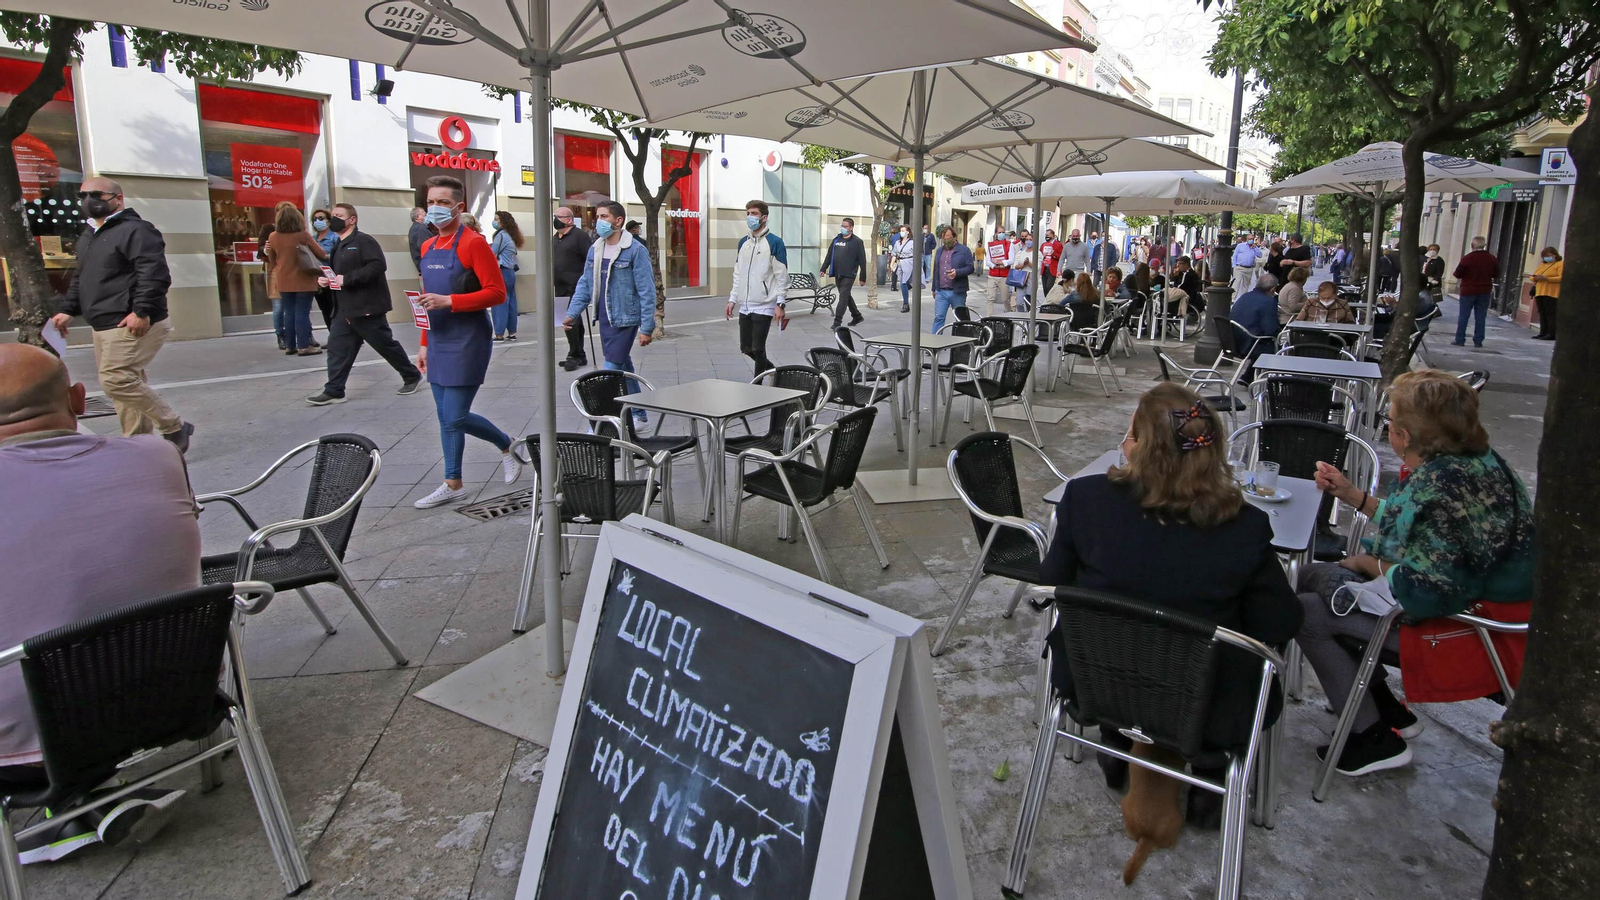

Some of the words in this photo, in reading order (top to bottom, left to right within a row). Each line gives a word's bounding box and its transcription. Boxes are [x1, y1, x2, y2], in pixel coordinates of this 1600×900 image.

[240, 159, 272, 169] Vodafone
[272, 161, 287, 169] One
[241, 166, 262, 175] Hogar
[262, 168, 293, 176] Ilimitable
[410, 151, 501, 173] vodafone
[969, 185, 996, 198] Estrella
[996, 183, 1024, 195] Galicia
[618, 594, 702, 681] LOCAL
[590, 736, 645, 802] HAY
[649, 781, 778, 888] MENÚ
[603, 813, 650, 884] DEL
